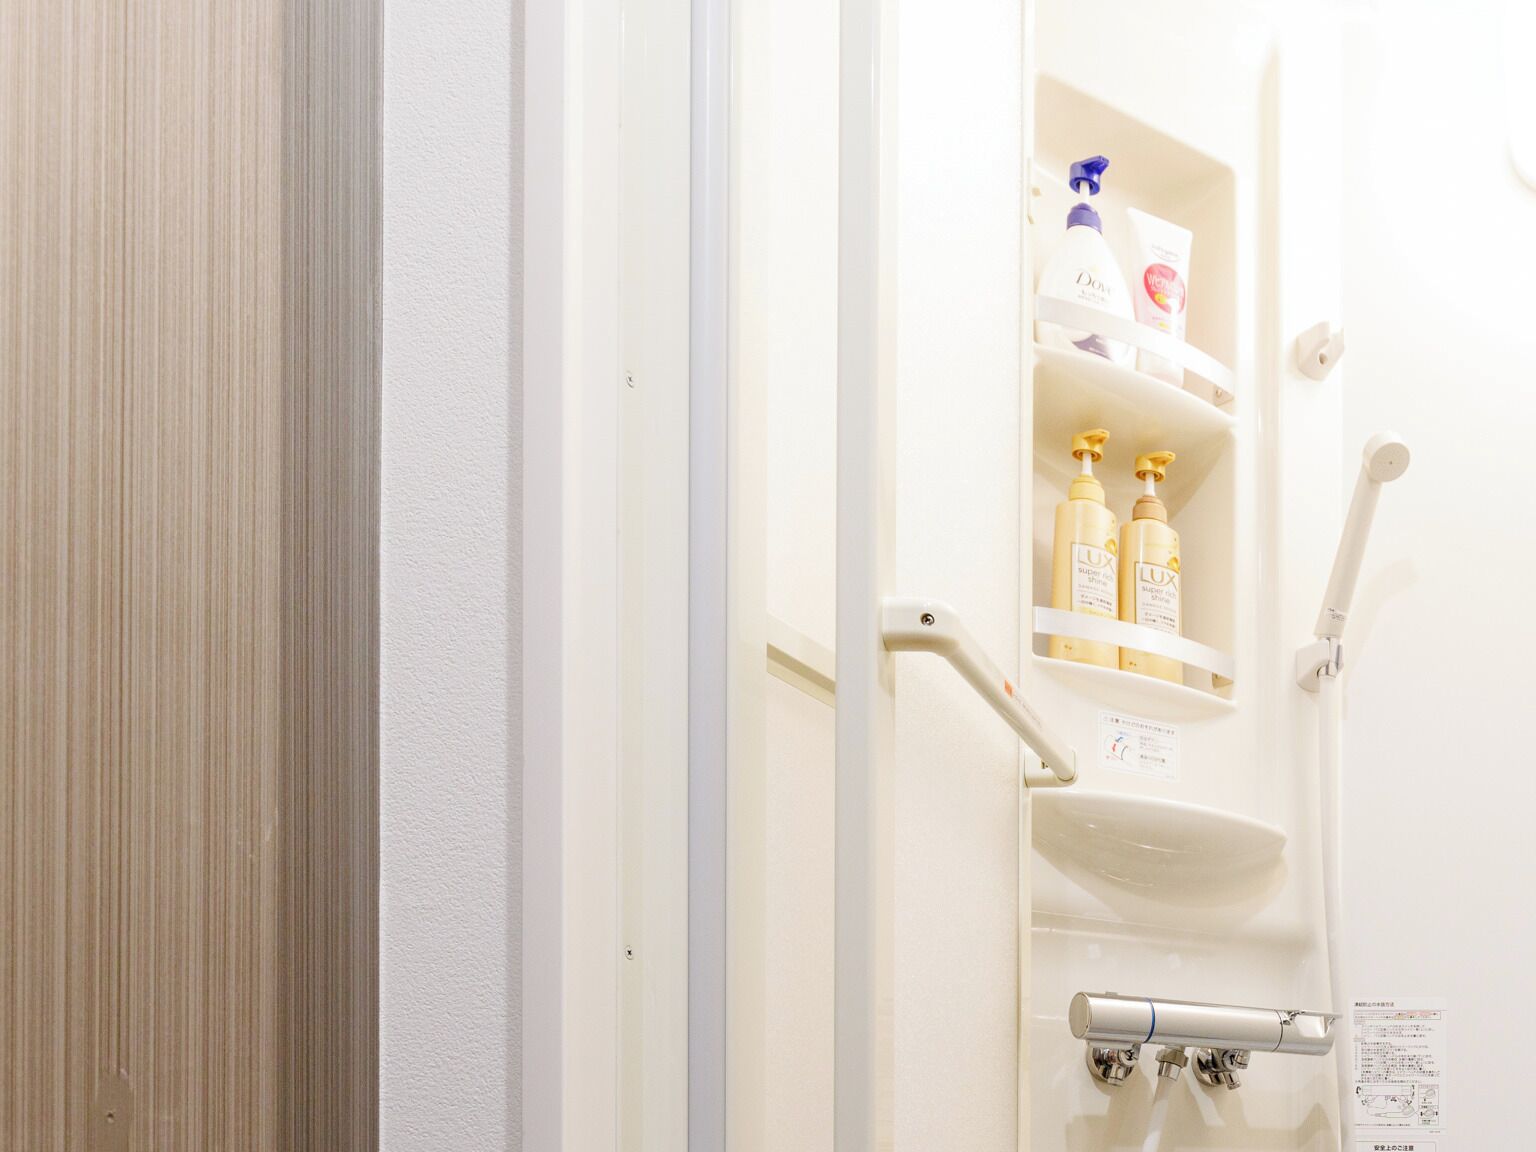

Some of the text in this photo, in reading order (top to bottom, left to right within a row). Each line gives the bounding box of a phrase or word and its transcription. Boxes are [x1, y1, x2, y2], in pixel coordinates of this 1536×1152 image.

[1078, 547, 1116, 574] LUX
[1078, 567, 1101, 577] super
[1087, 575, 1108, 587] shine
[1141, 566, 1178, 592] LUX
[1141, 585, 1177, 600] super rich
[1151, 594, 1171, 604] shine
